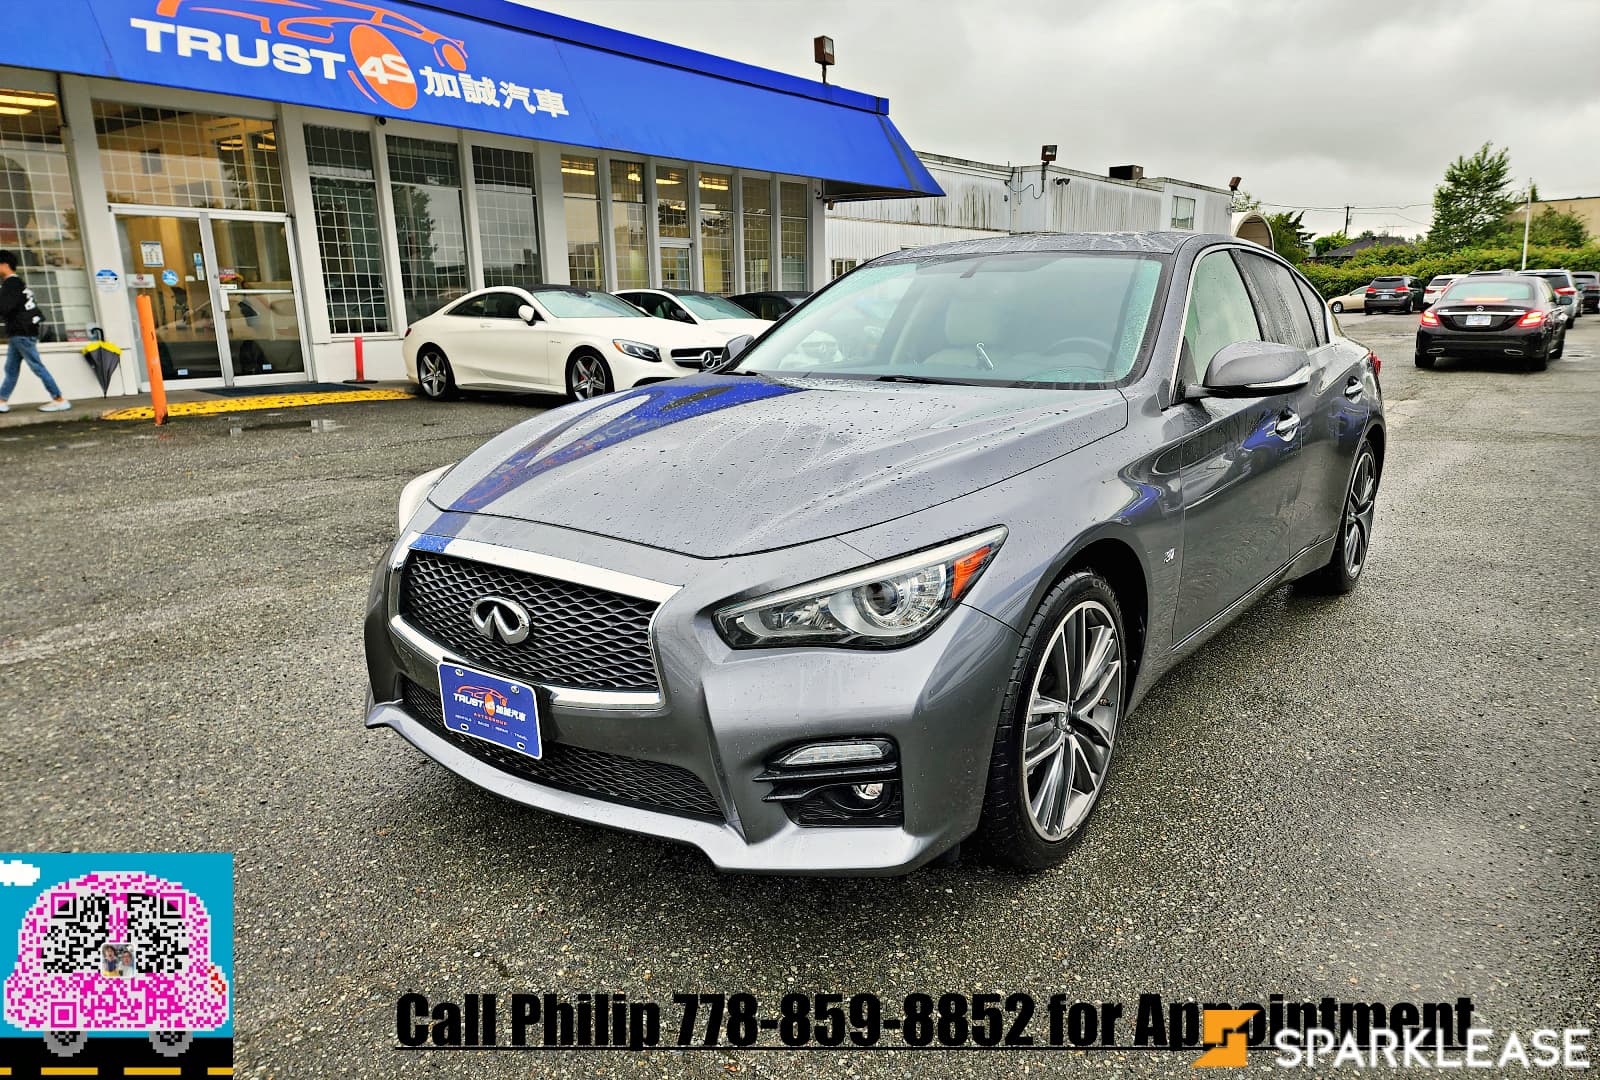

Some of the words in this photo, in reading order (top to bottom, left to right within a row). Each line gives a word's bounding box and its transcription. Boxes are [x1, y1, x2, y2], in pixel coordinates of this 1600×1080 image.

[130, 17, 346, 80] TRUST
[360, 53, 416, 84] 4S
[419, 66, 570, 118] 加誠汽車
[453, 693, 484, 708] TRUST
